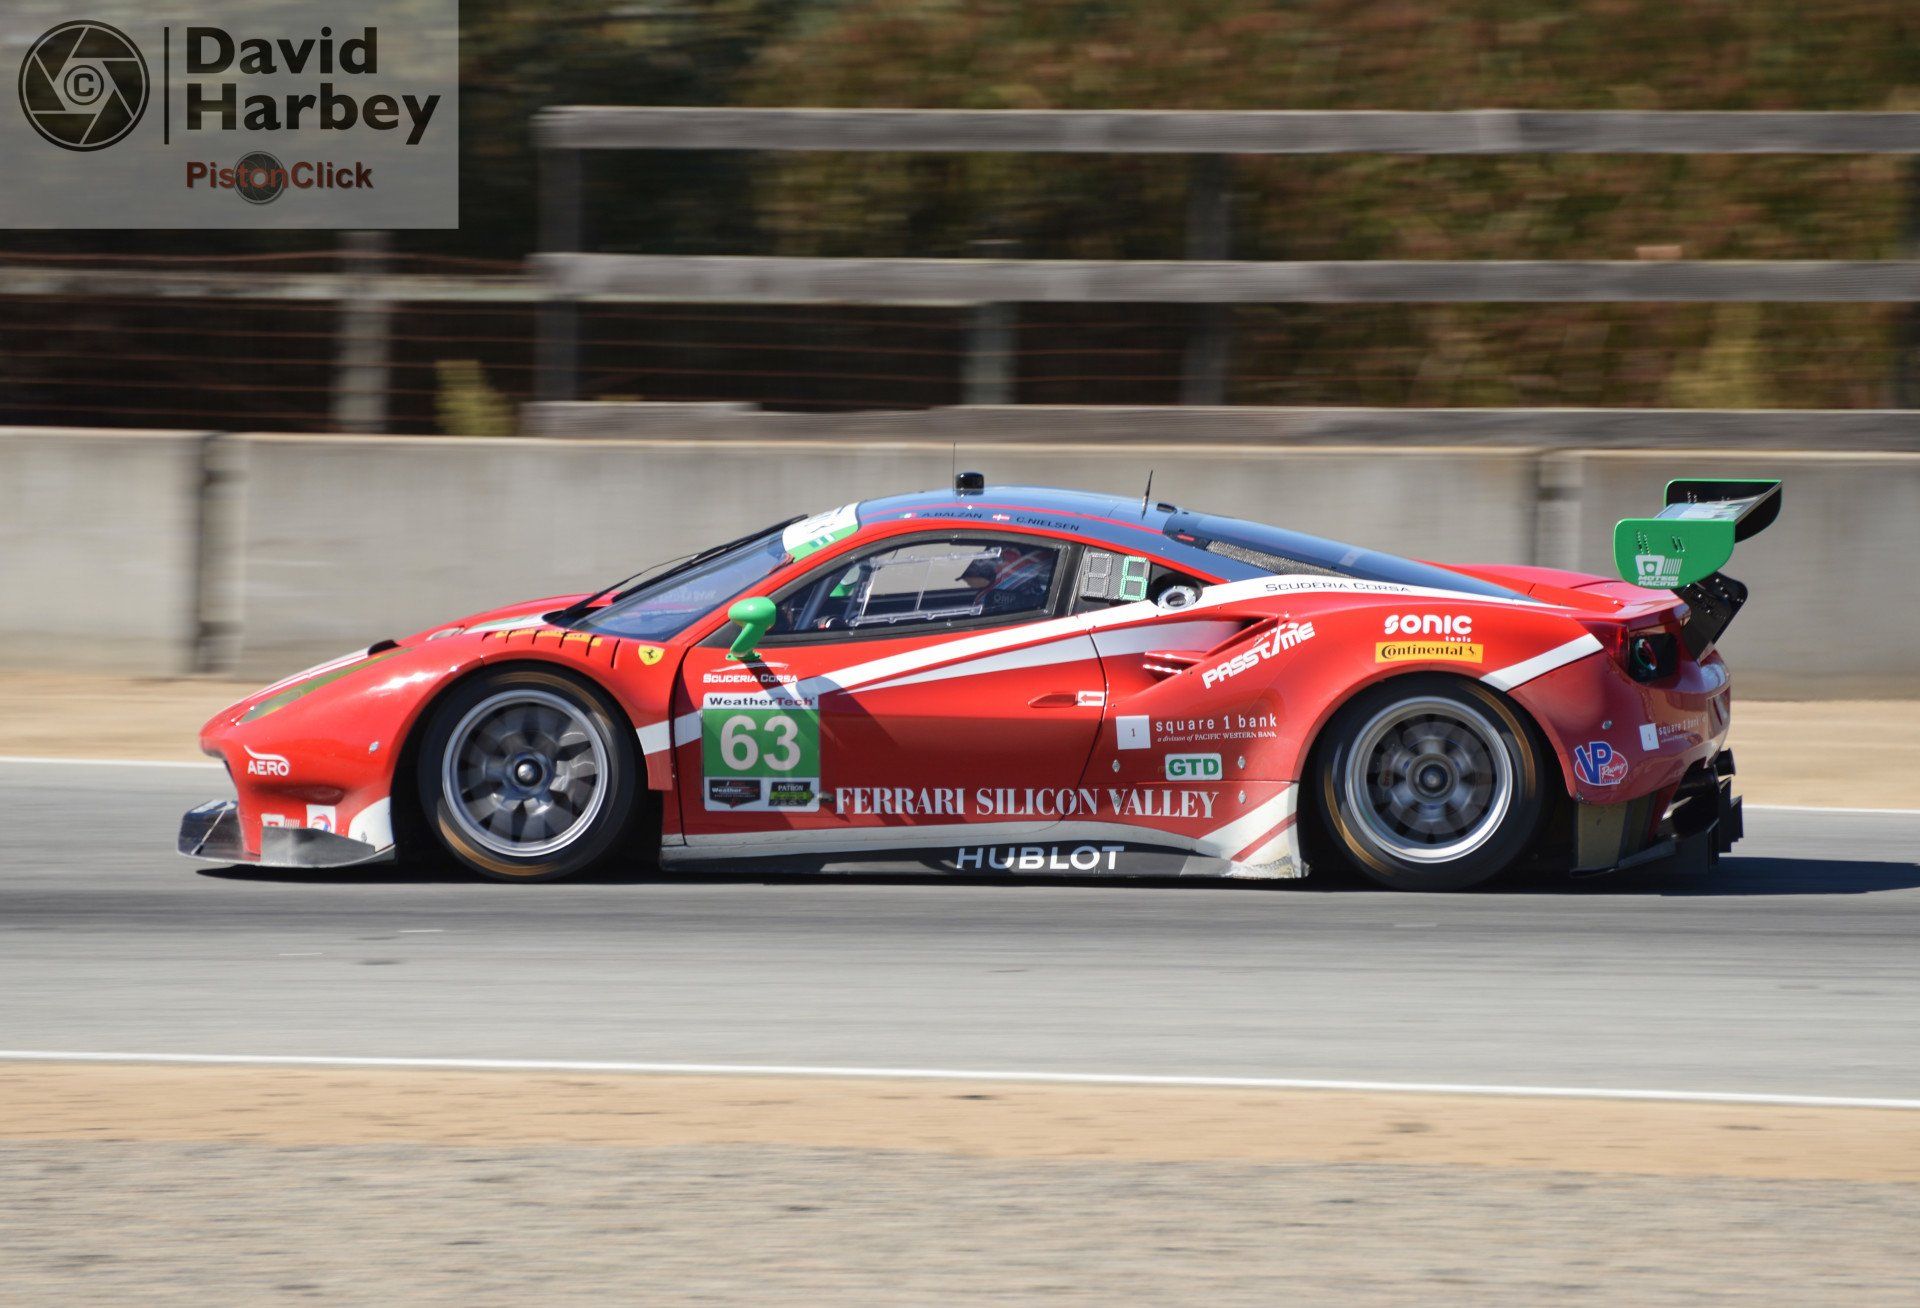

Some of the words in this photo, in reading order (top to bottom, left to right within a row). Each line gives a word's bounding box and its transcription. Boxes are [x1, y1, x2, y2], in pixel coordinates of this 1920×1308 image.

[1016, 517, 1080, 532] C.NIELSEN
[1381, 645, 1463, 659] Continental
[709, 697, 815, 706] WeatherTech
[1155, 718, 1215, 734] square
[1223, 715, 1230, 730] 1
[1238, 713, 1277, 728] bank
[720, 715, 801, 771] 63
[1194, 732, 1222, 741] PACIFIC
[1222, 731, 1257, 739] WESTERN
[1258, 730, 1277, 738] BANK
[247, 760, 290, 776] AERO
[1168, 758, 1220, 776] GTD
[1574, 741, 1613, 786] VP
[835, 787, 966, 815] FERRARI
[976, 787, 1099, 816] SILICON
[1107, 788, 1220, 819] VALLEY
[956, 845, 1125, 870] HUBLOT
